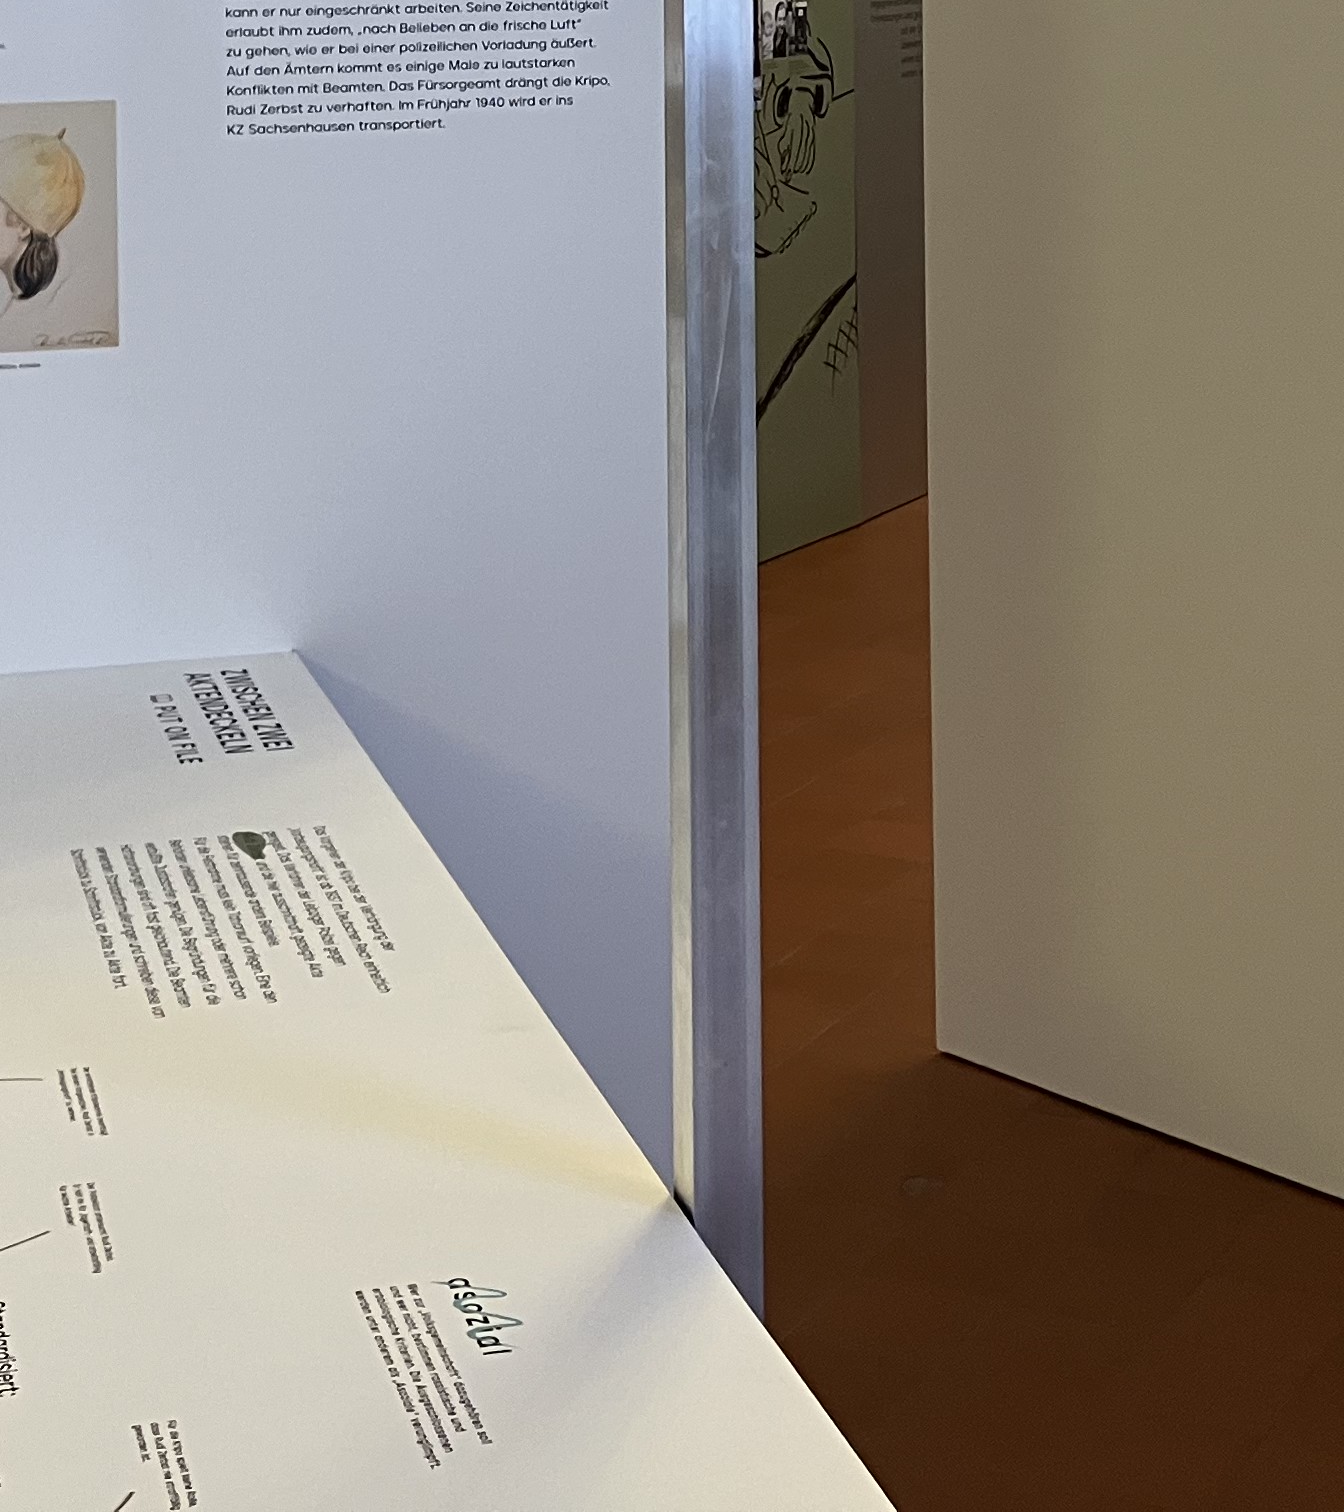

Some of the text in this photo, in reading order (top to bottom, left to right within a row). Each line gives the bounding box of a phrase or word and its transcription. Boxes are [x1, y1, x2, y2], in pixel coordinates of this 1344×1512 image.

[225, 7, 258, 18] kann
[262, 8, 276, 18] er
[279, 7, 302, 17] nur
[465, 1, 502, 13] Seine
[225, 26, 275, 38] erlaubt
[278, 25, 303, 36] ihm
[399, 22, 456, 34] Belieben
[459, 23, 476, 32] an
[478, 21, 499, 32] die
[503, 19, 547, 31] frische
[226, 48, 242, 58] zu
[294, 44, 317, 56] wie
[321, 45, 335, 55] er
[338, 43, 359, 54] bei
[362, 43, 396, 54] einer
[481, 39, 547, 52] Vorladung
[226, 65, 250, 77] Auf
[254, 65, 280, 76] den
[283, 61, 334, 76] Ämtern
[337, 62, 383, 74] kommt
[386, 63, 402, 73] es
[405, 60, 445, 74] einige
[448, 59, 480, 71] Male
[483, 61, 498, 70] zu
[226, 84, 294, 96] Konflikten
[297, 83, 319, 94] mit
[389, 80, 415, 92] Das
[505, 76, 549, 90] drängt
[552, 76, 572, 87] die
[226, 104, 256, 116] Rudi
[260, 103, 303, 115] Zerbst
[307, 104, 322, 114] zu
[398, 100, 414, 111] Im
[417, 98, 471, 112] Frühjahr
[475, 96, 505, 108] 1940
[508, 96, 536, 107] wird
[539, 97, 553, 106] er
[555, 95, 573, 106] ins
[227, 124, 244, 136] KZ
